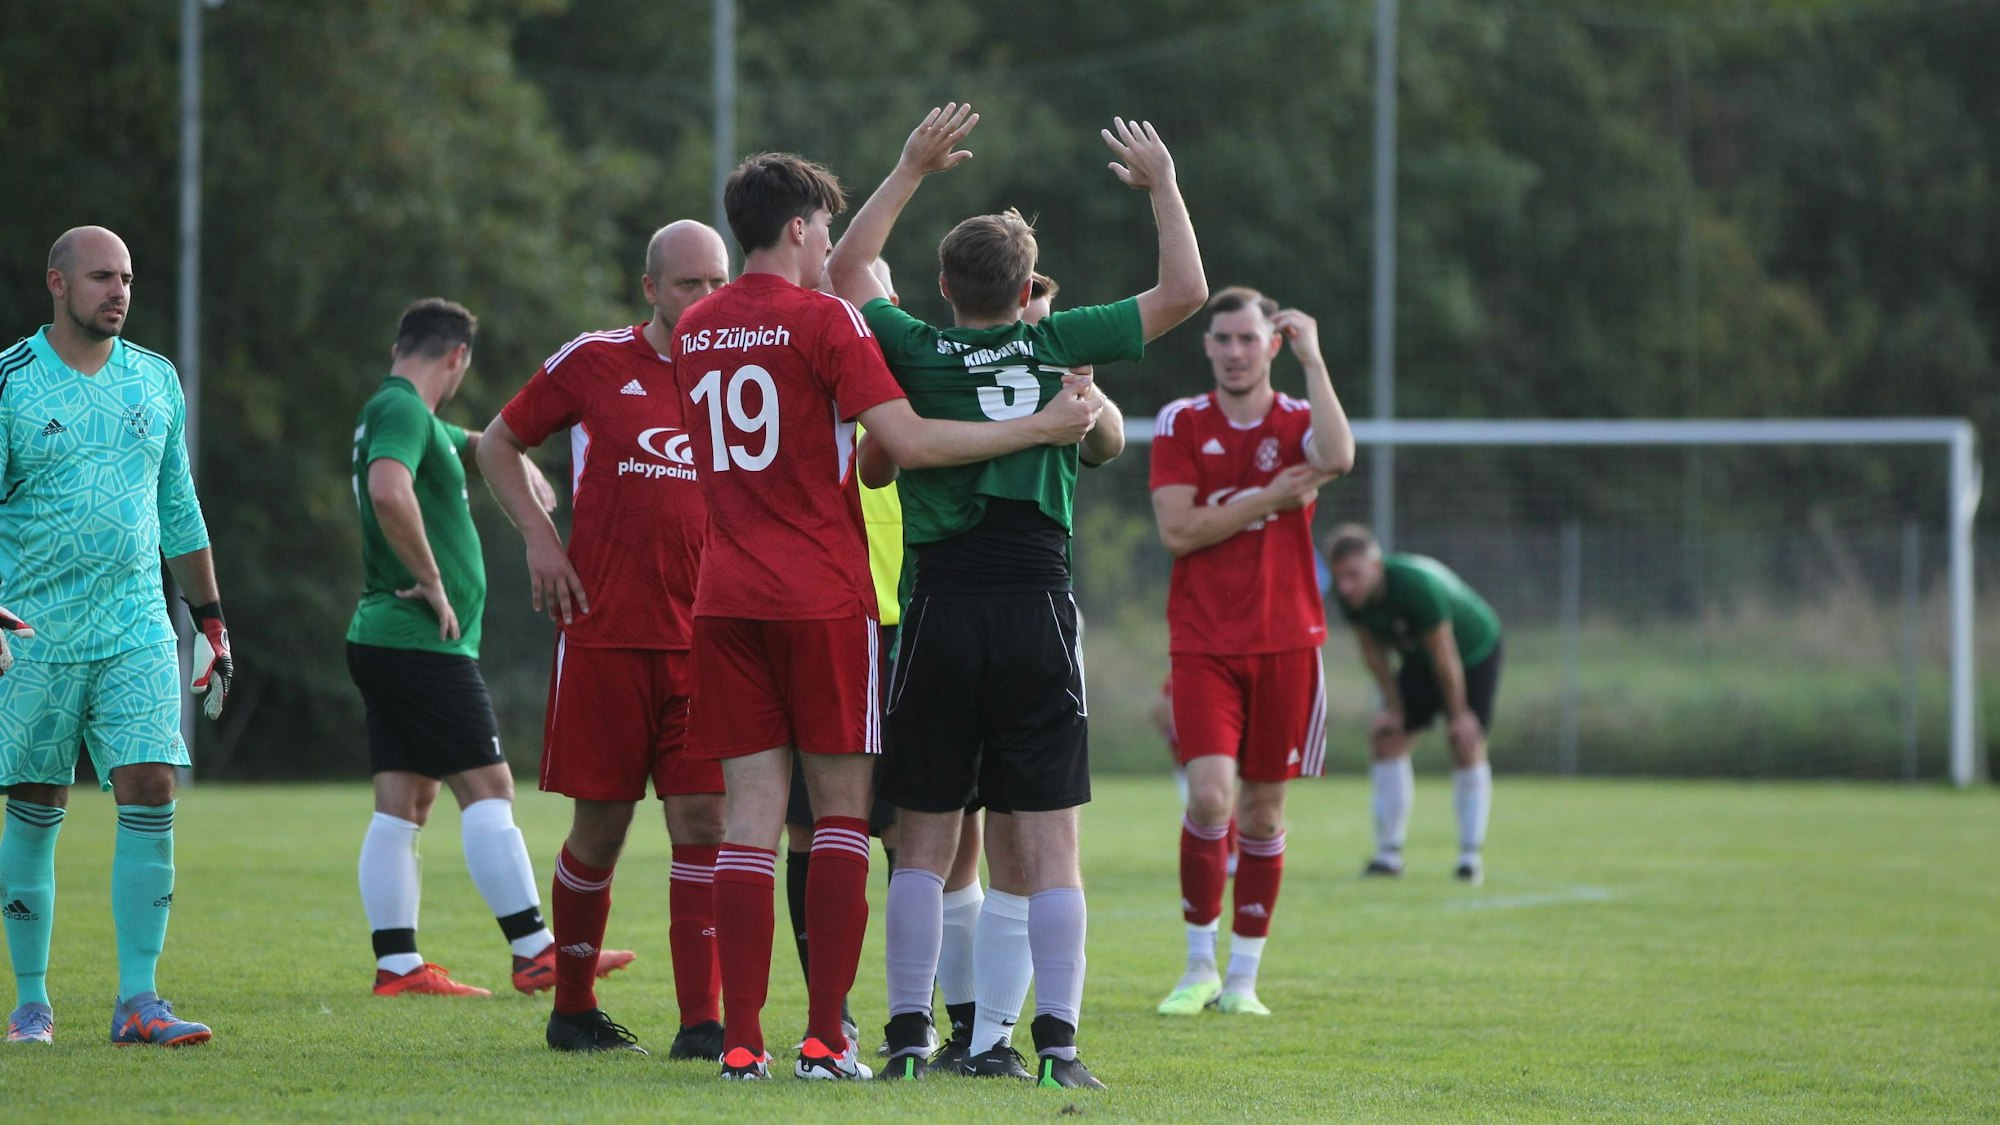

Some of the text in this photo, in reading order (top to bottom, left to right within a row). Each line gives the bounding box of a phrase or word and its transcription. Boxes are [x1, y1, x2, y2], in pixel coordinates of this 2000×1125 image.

[681, 325, 790, 355] TuS Zülpich
[620, 388, 647, 397] adidas
[968, 364, 1073, 421] 3
[41, 426, 68, 437] adidas
[689, 364, 780, 472] 19
